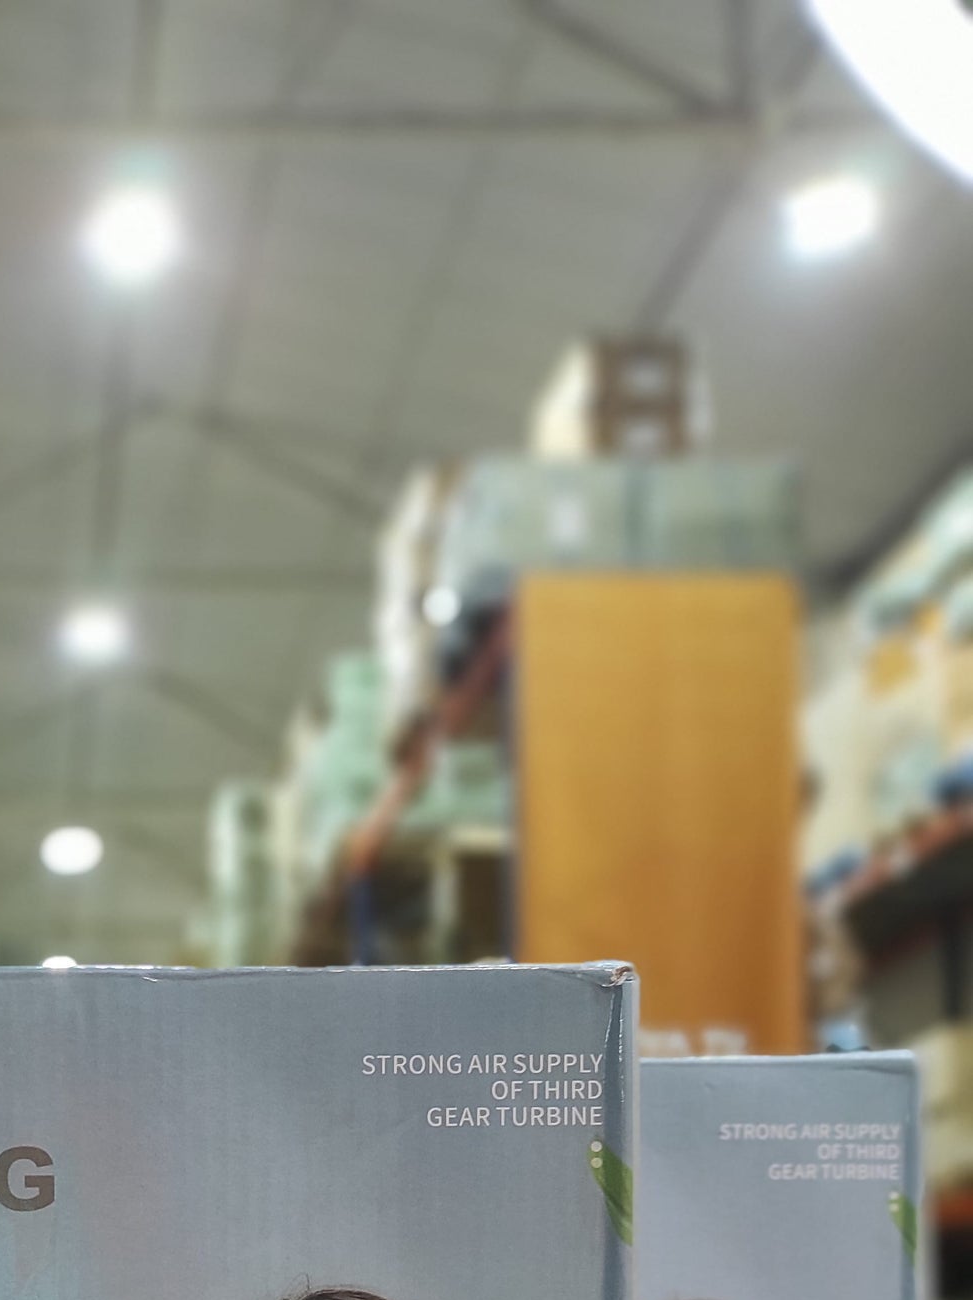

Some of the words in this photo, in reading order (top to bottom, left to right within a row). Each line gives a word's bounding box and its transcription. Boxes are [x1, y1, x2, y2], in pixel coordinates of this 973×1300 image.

[362, 1054, 462, 1075] STRONG
[467, 1054, 507, 1074] AIR
[513, 1053, 603, 1074] SUPPLY
[491, 1080, 523, 1100] OF
[528, 1080, 603, 1100] THIRD
[427, 1107, 490, 1127] GEAR
[496, 1106, 603, 1126] TURBINE
[719, 1124, 796, 1141] STRONG
[800, 1123, 830, 1140] AIR
[834, 1123, 900, 1140] SUPPLY
[817, 1144, 842, 1160] OF
[846, 1144, 900, 1160] THIRD
[768, 1164, 817, 1180] GEAR
[822, 1164, 899, 1180] TURBINE
